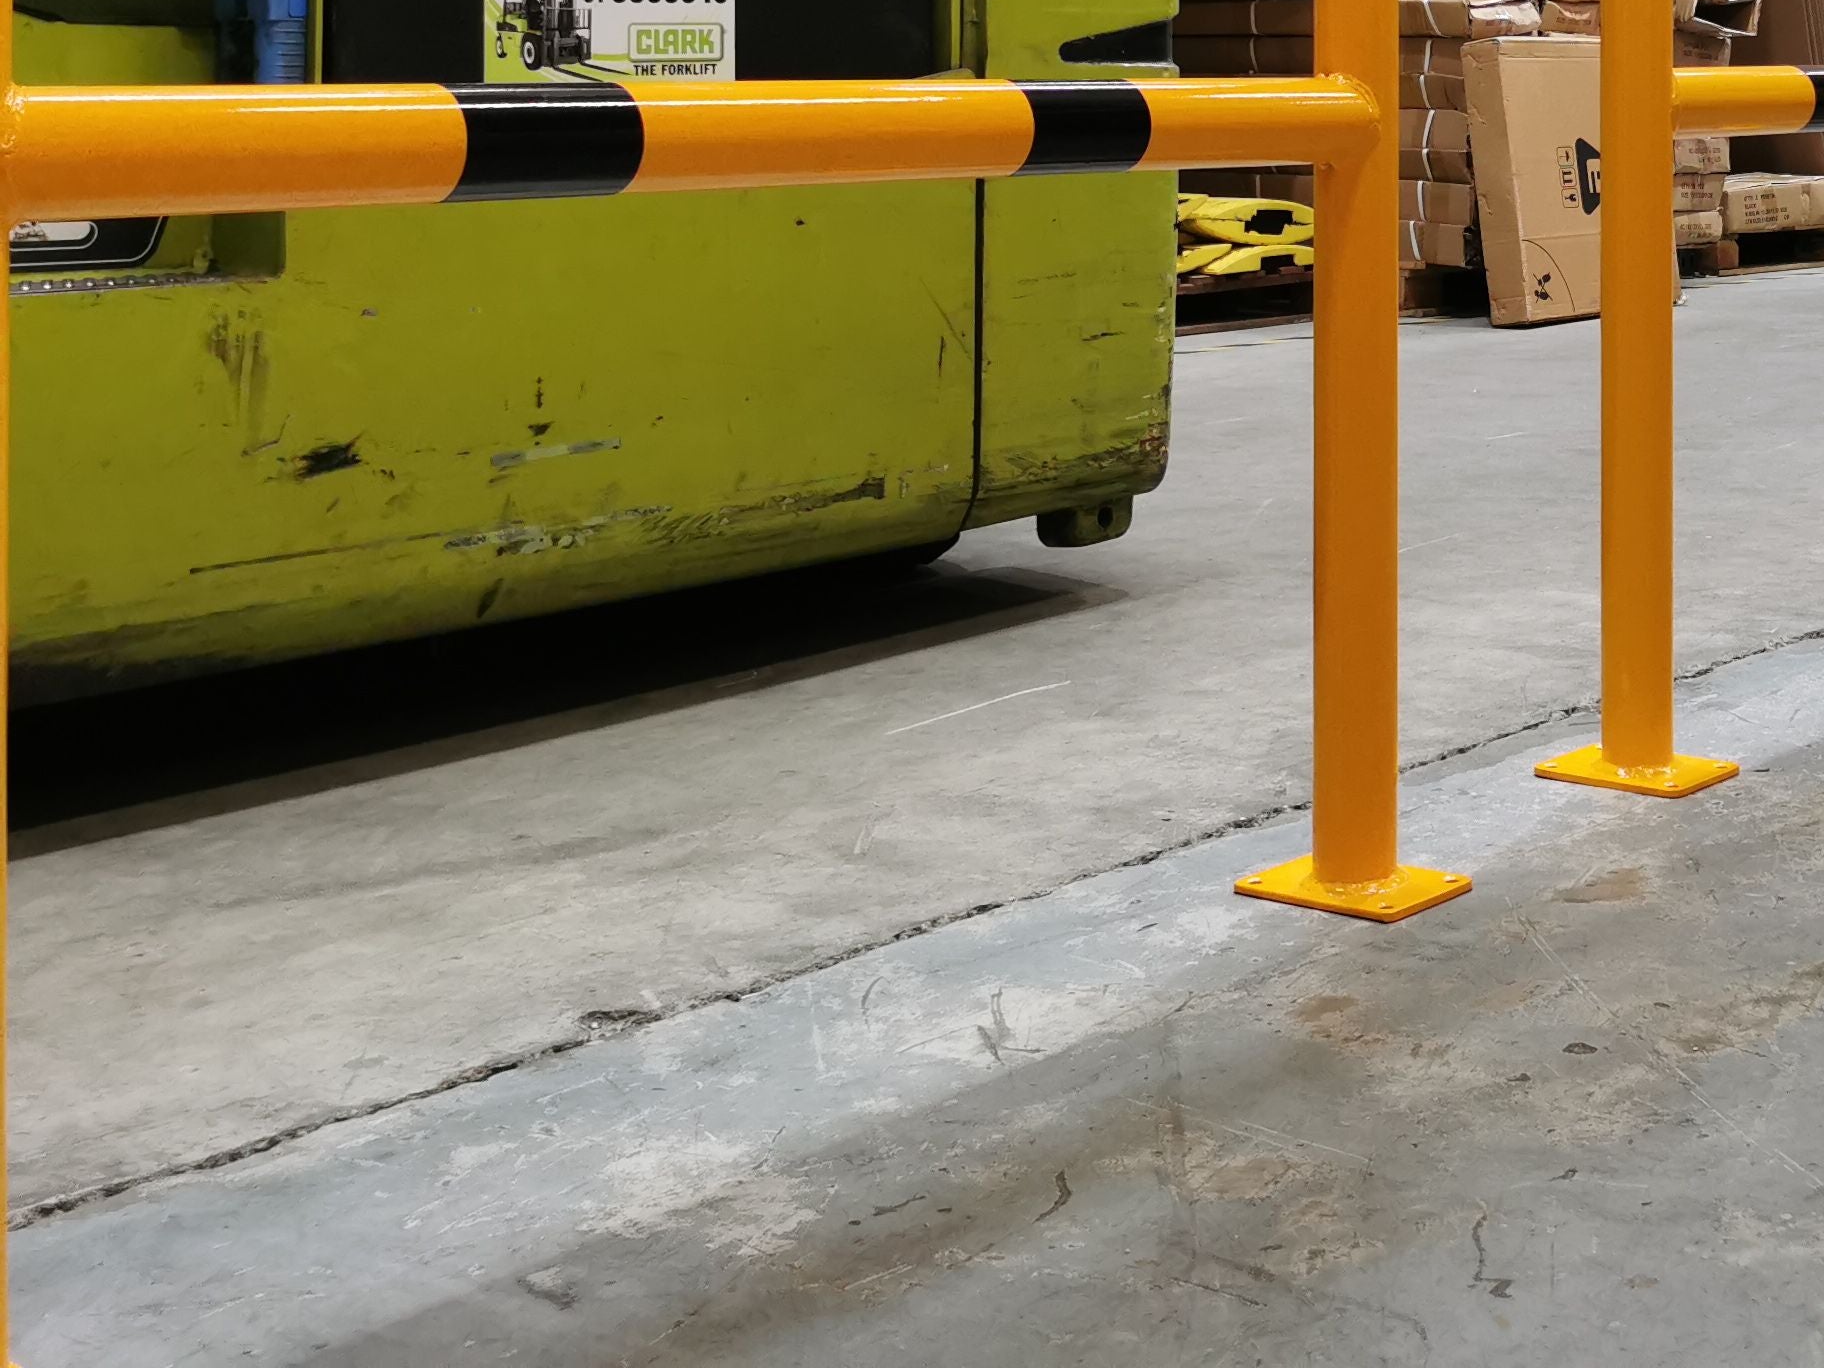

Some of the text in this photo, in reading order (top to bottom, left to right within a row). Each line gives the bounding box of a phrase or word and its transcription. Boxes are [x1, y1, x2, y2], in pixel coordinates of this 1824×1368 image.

[636, 29, 716, 55] CLARK
[634, 63, 717, 76] THE FORKLIFT
